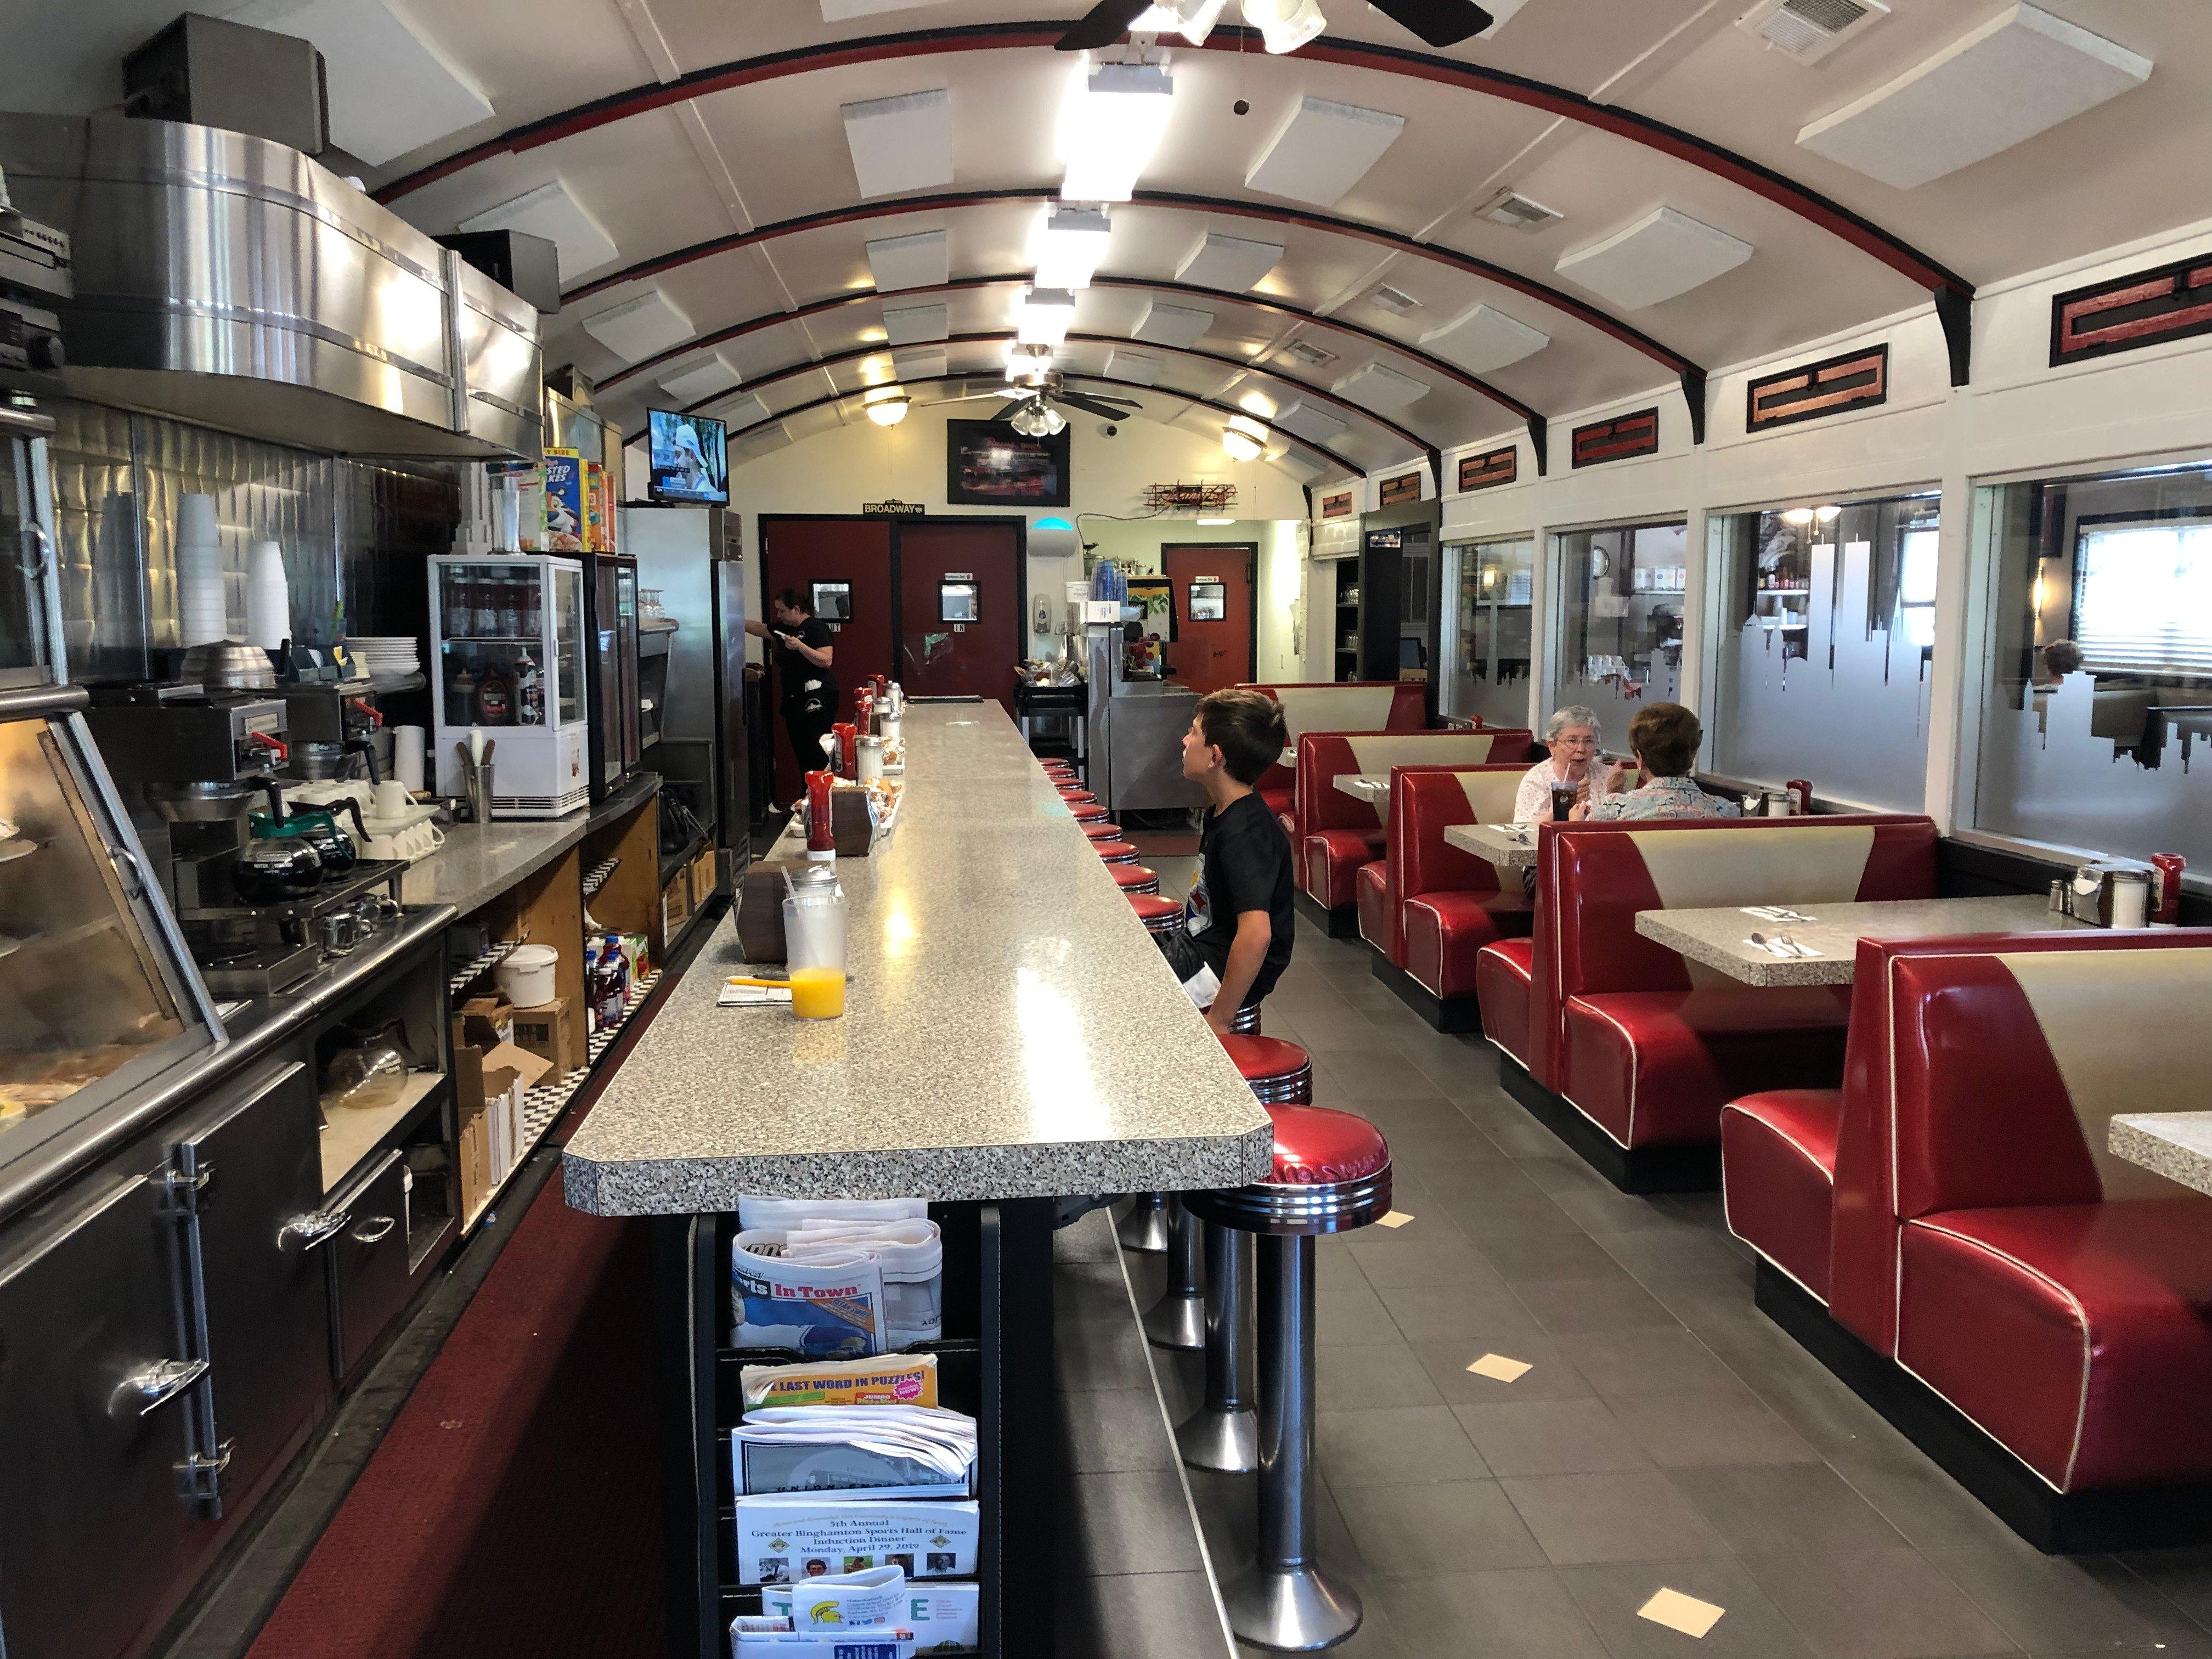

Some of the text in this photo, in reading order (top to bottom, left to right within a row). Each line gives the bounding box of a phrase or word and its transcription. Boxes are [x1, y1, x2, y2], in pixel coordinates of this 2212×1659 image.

[865, 505, 916, 514] BROADWAY
[780, 1381, 810, 1391] LAST
[812, 1379, 852, 1389] WORD
[855, 1378, 868, 1387] IN
[795, 1530, 862, 1538] Binghamton
[865, 1528, 898, 1536] Sports
[800, 1546, 845, 1554] Monday,
[848, 1544, 875, 1554] April
